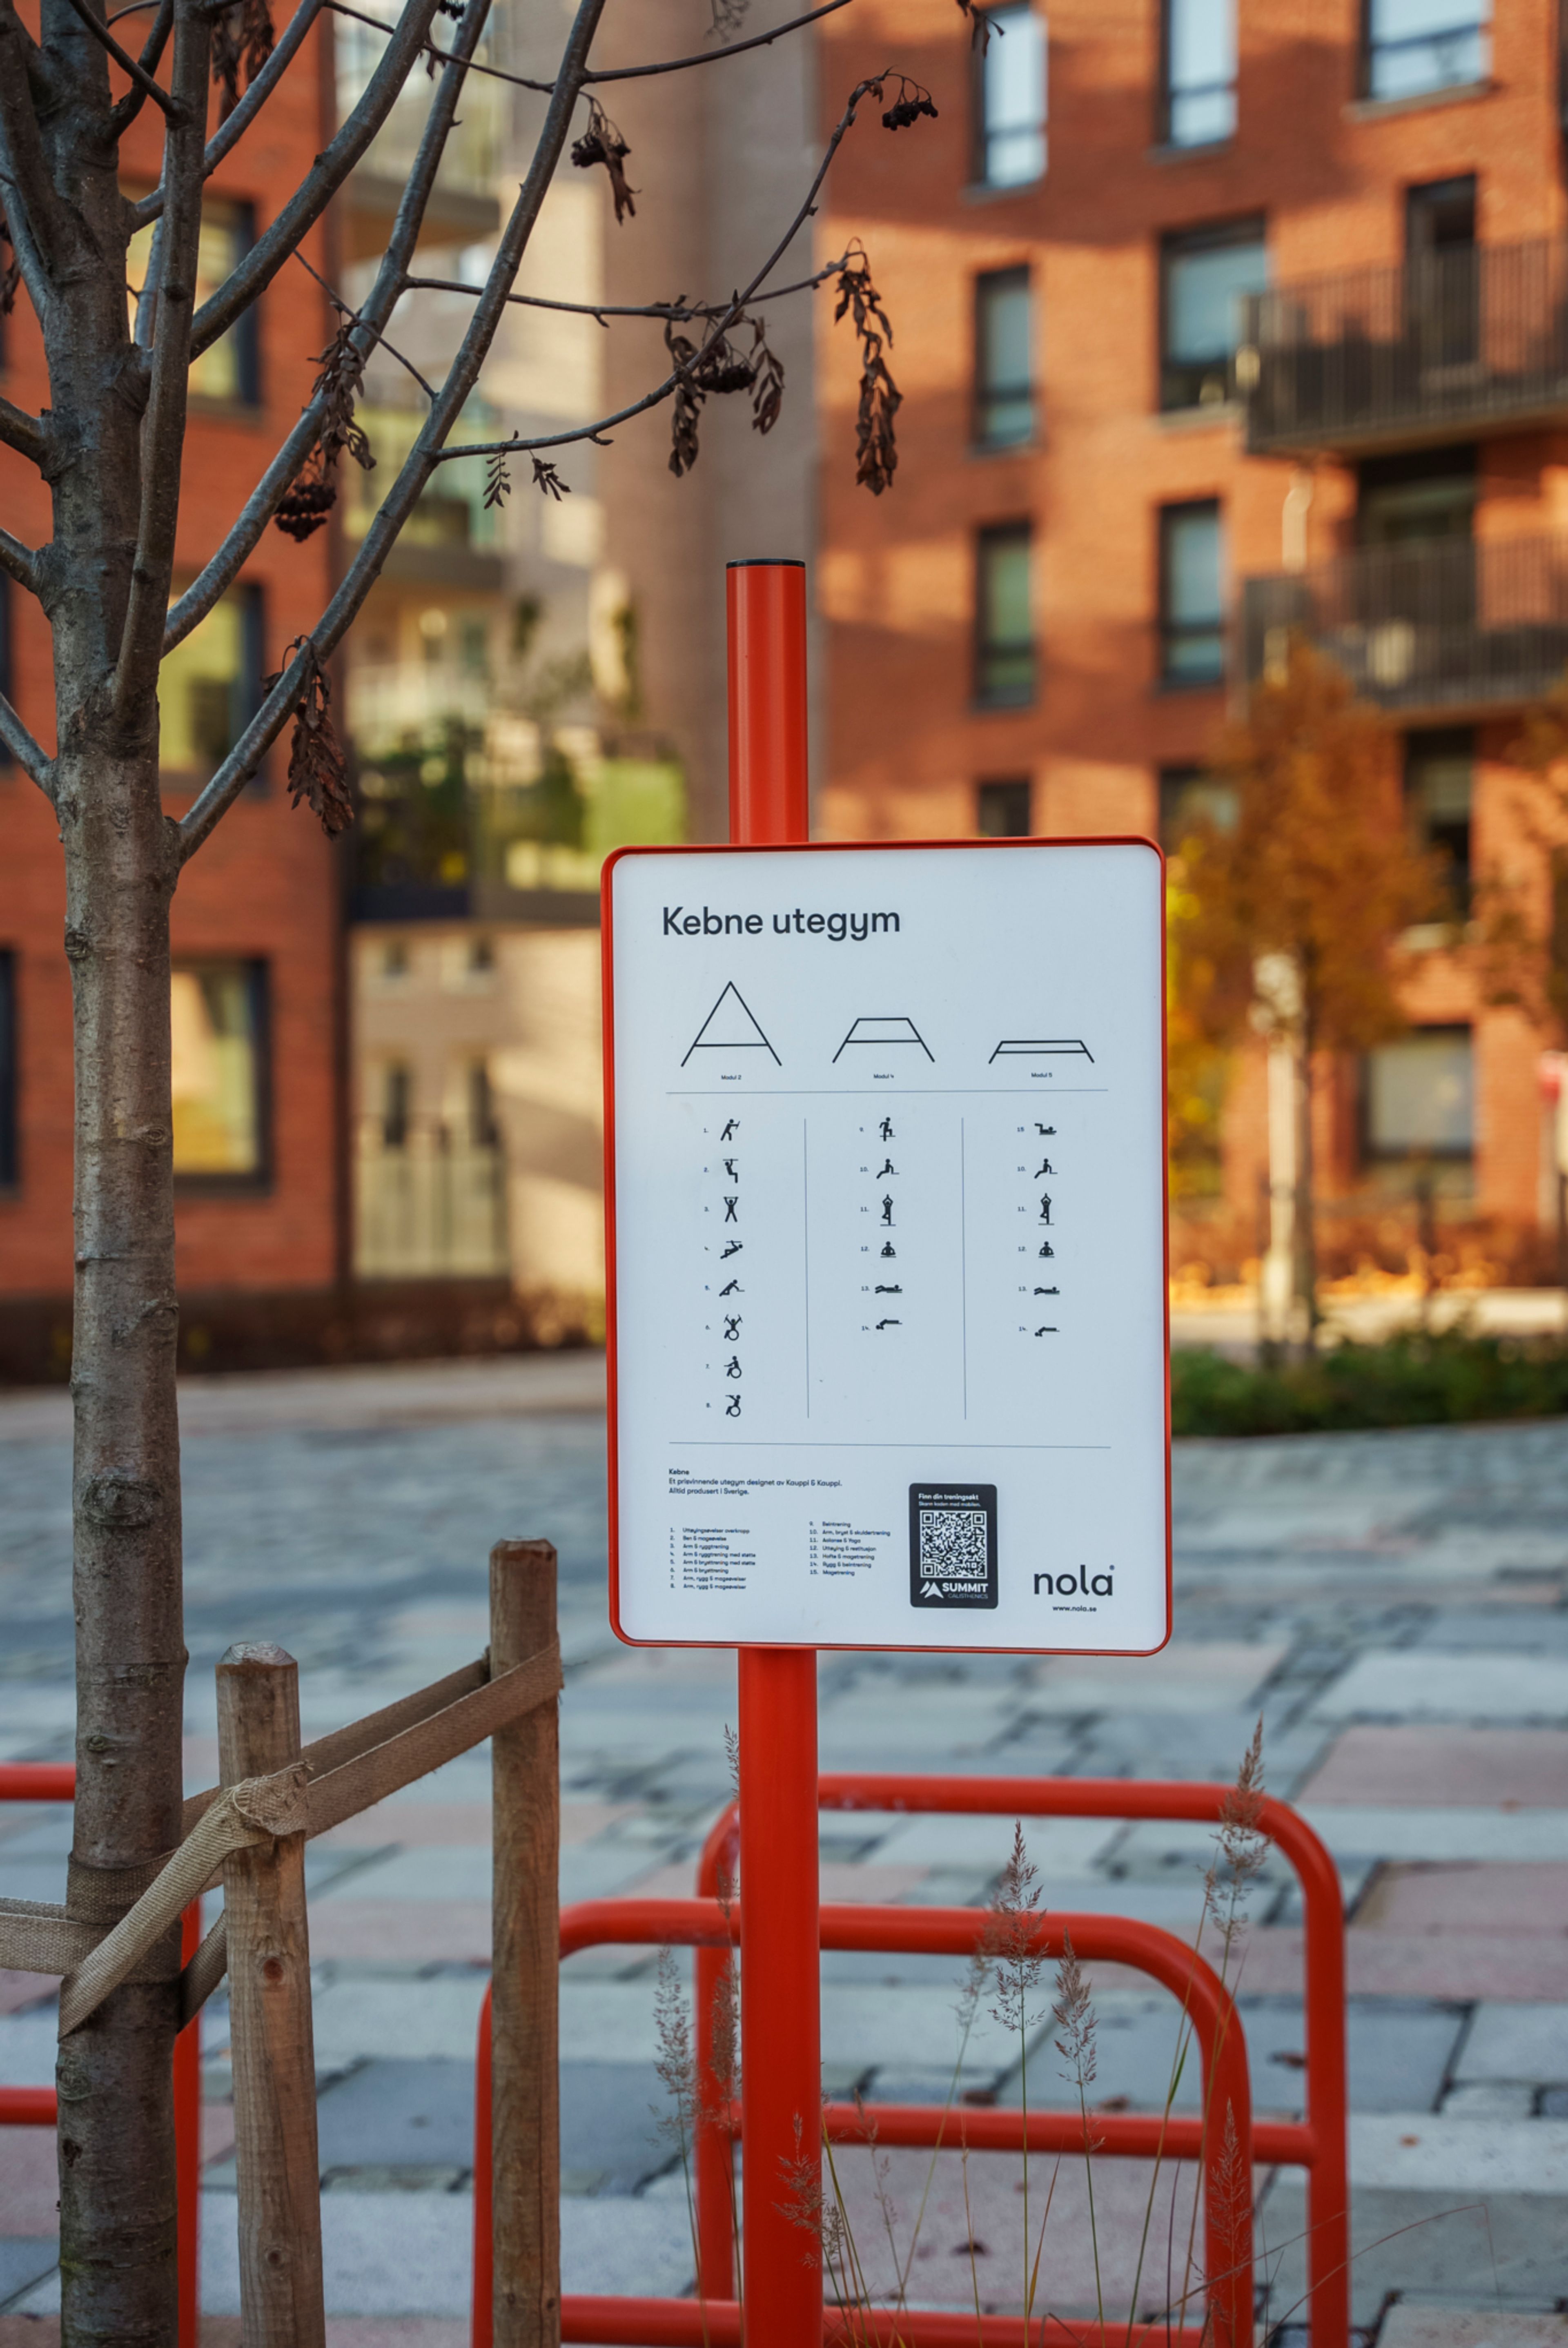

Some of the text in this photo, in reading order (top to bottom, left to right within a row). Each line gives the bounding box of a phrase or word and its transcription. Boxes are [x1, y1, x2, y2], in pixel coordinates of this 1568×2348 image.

[663, 906, 900, 942] Kebne utegym
[746, 1479, 775, 1487] designet
[817, 1479, 842, 1488] Kauppi.
[724, 1488, 749, 1497] Sverige.
[942, 1582, 989, 1593] SUMMIT
